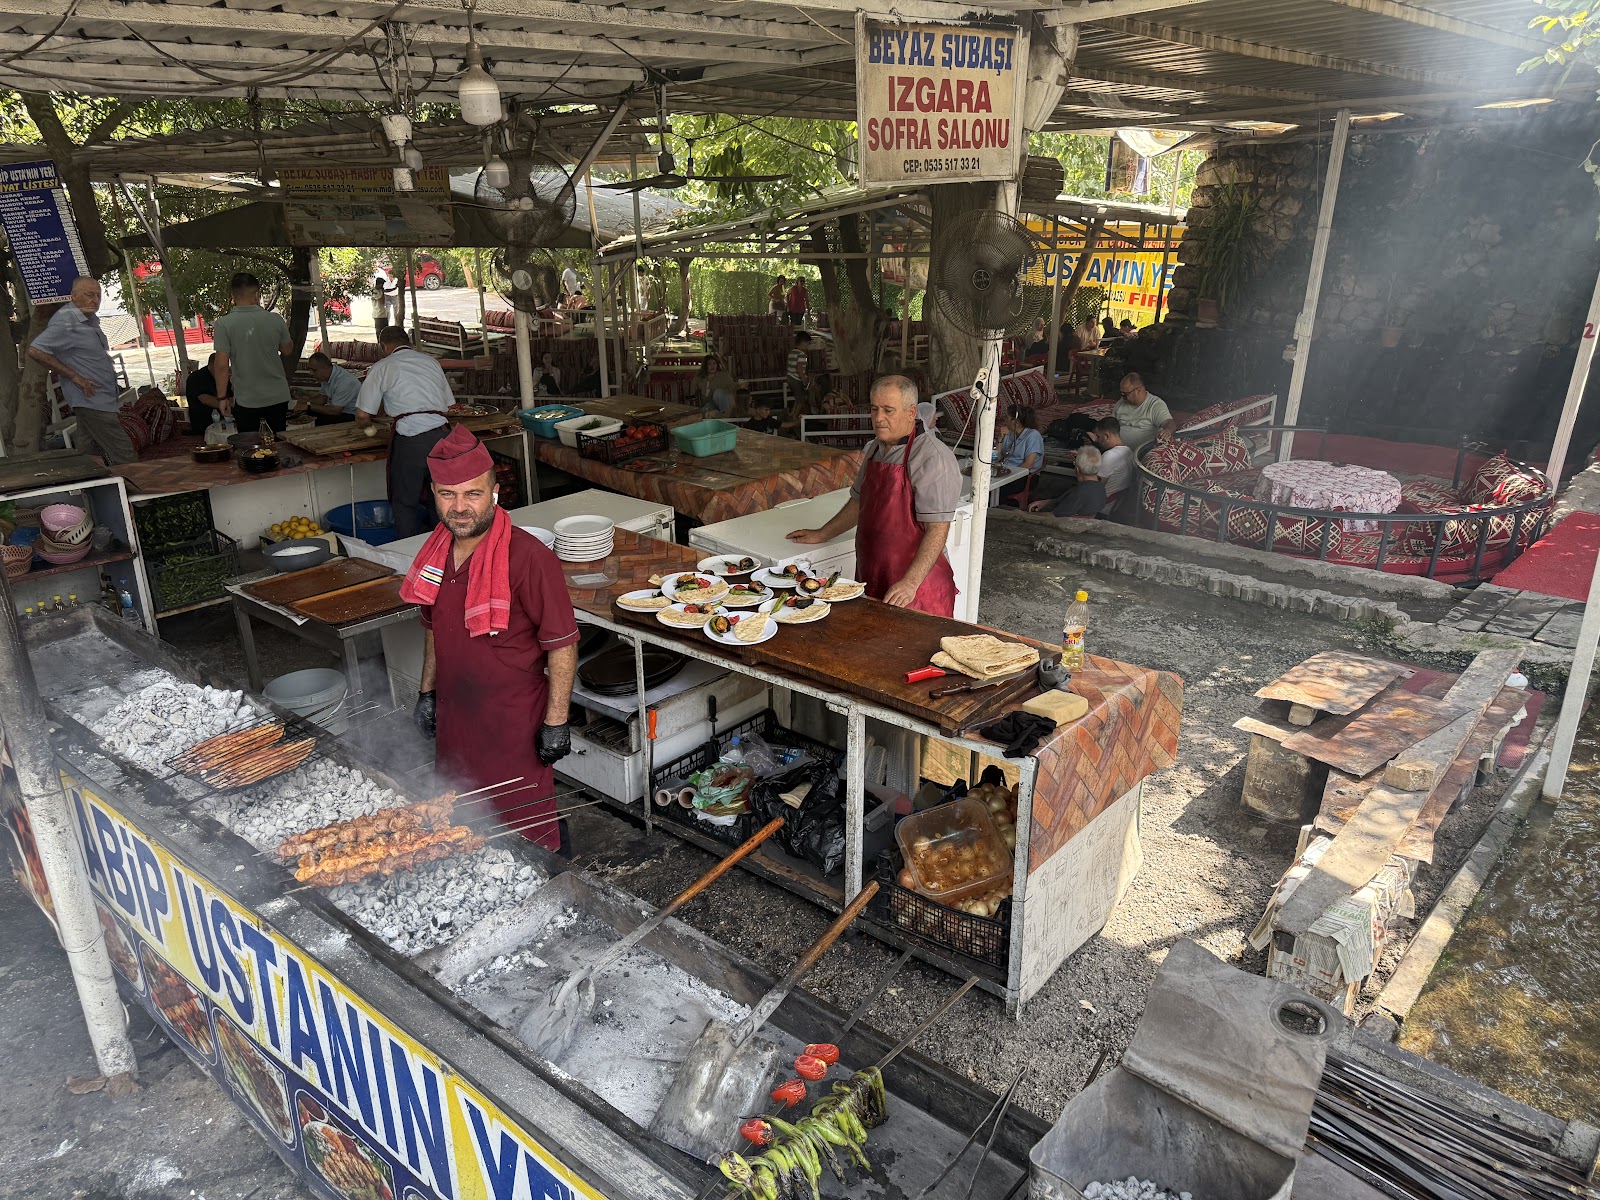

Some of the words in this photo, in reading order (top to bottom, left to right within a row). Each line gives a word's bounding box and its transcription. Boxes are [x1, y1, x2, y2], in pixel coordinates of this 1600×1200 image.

[869, 29, 935, 66] BEYAZ
[941, 33, 1014, 76] ŞUBAŞI
[888, 75, 992, 113] IZGARA
[868, 117, 931, 151] SOFRA
[937, 118, 1010, 150] SALONU
[40, 164, 55, 178] YERİ
[903, 160, 922, 173] CEP:
[924, 159, 943, 172] 0535
[945, 158, 958, 171] 517
[960, 157, 970, 170] 33
[971, 157, 980, 170] 21
[23, 177, 58, 190] LİSTESİ
[1583, 322, 1595, 339] 2
[171, 865, 454, 1200] USTANIN
